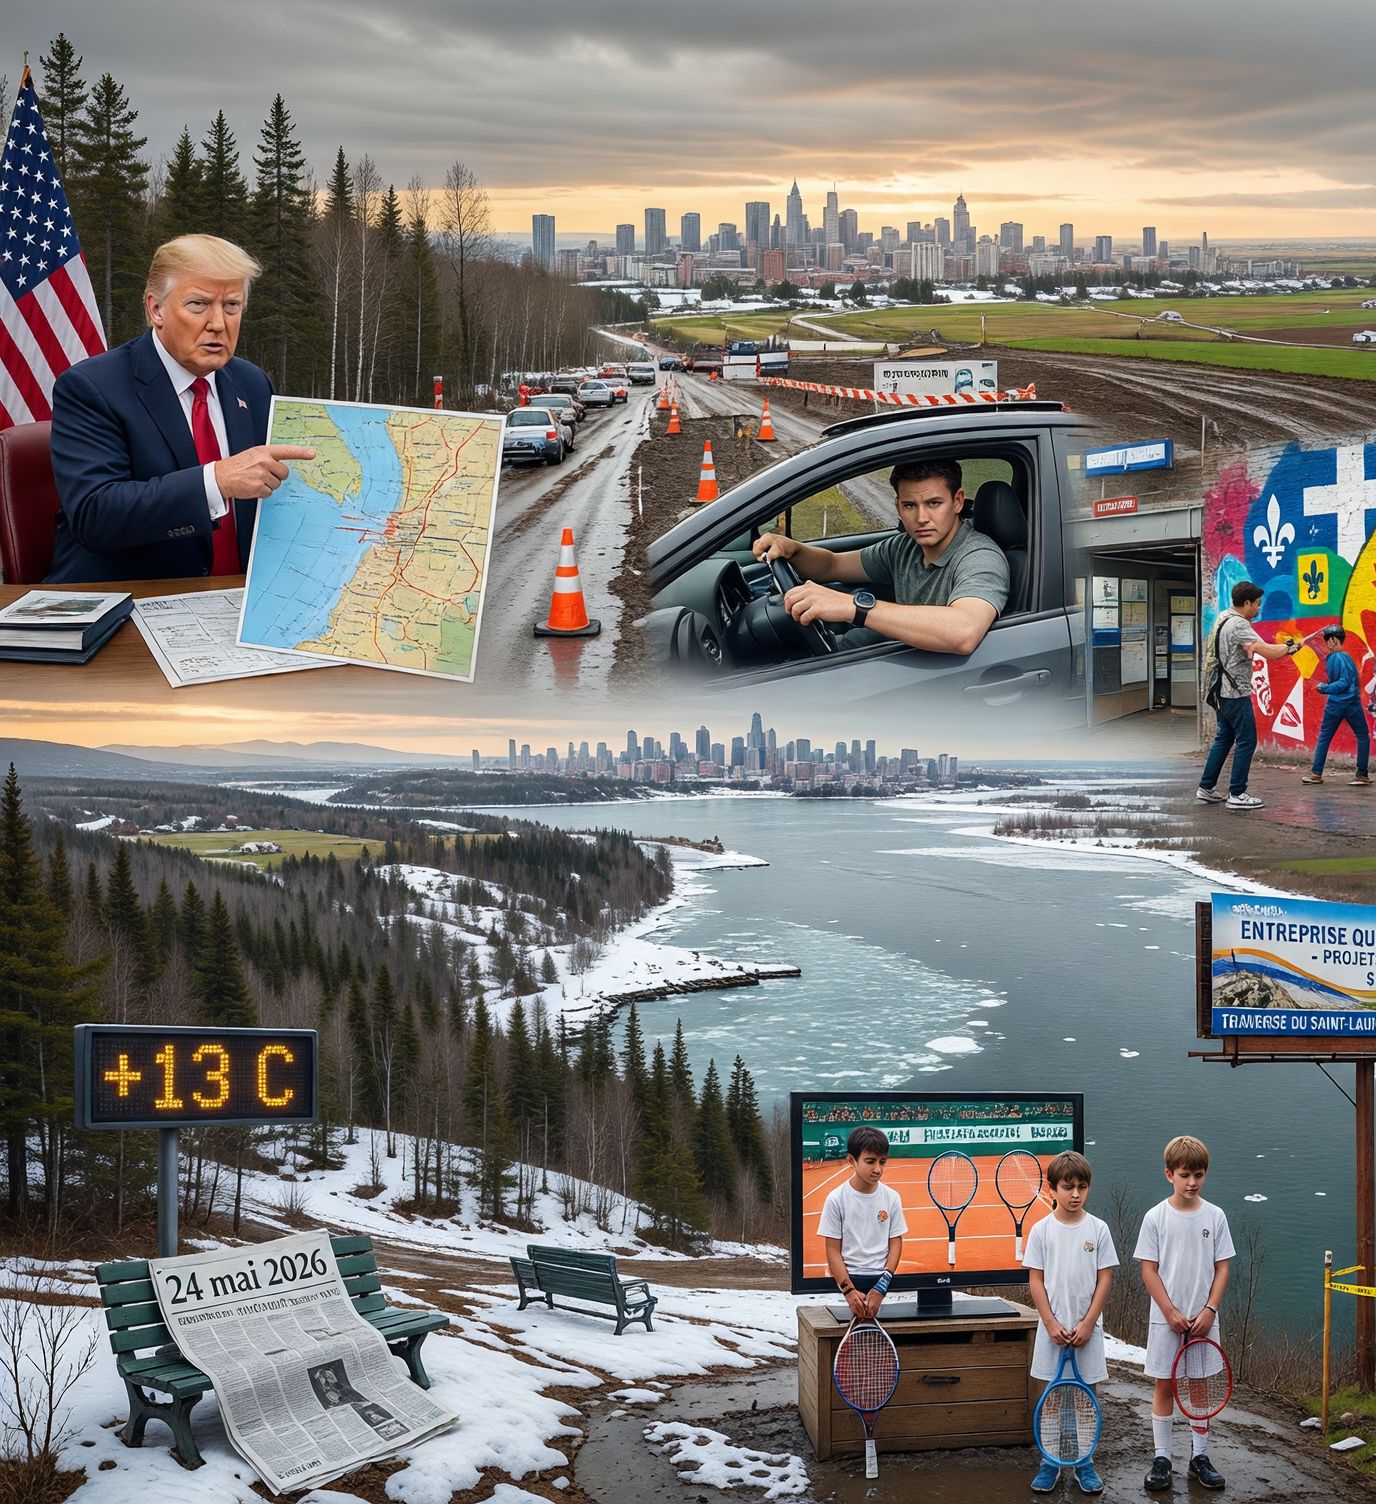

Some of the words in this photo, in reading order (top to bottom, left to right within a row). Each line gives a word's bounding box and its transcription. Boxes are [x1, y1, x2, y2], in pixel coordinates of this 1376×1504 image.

[1240, 920, 1347, 946] ENTREPRISE
[1291, 1016, 1308, 1031] DU
[103, 1043, 230, 1110] +13
[257, 1043, 294, 1108] C
[165, 1271, 204, 1305] 24
[209, 1260, 262, 1298] mai
[263, 1248, 328, 1287] 2026
